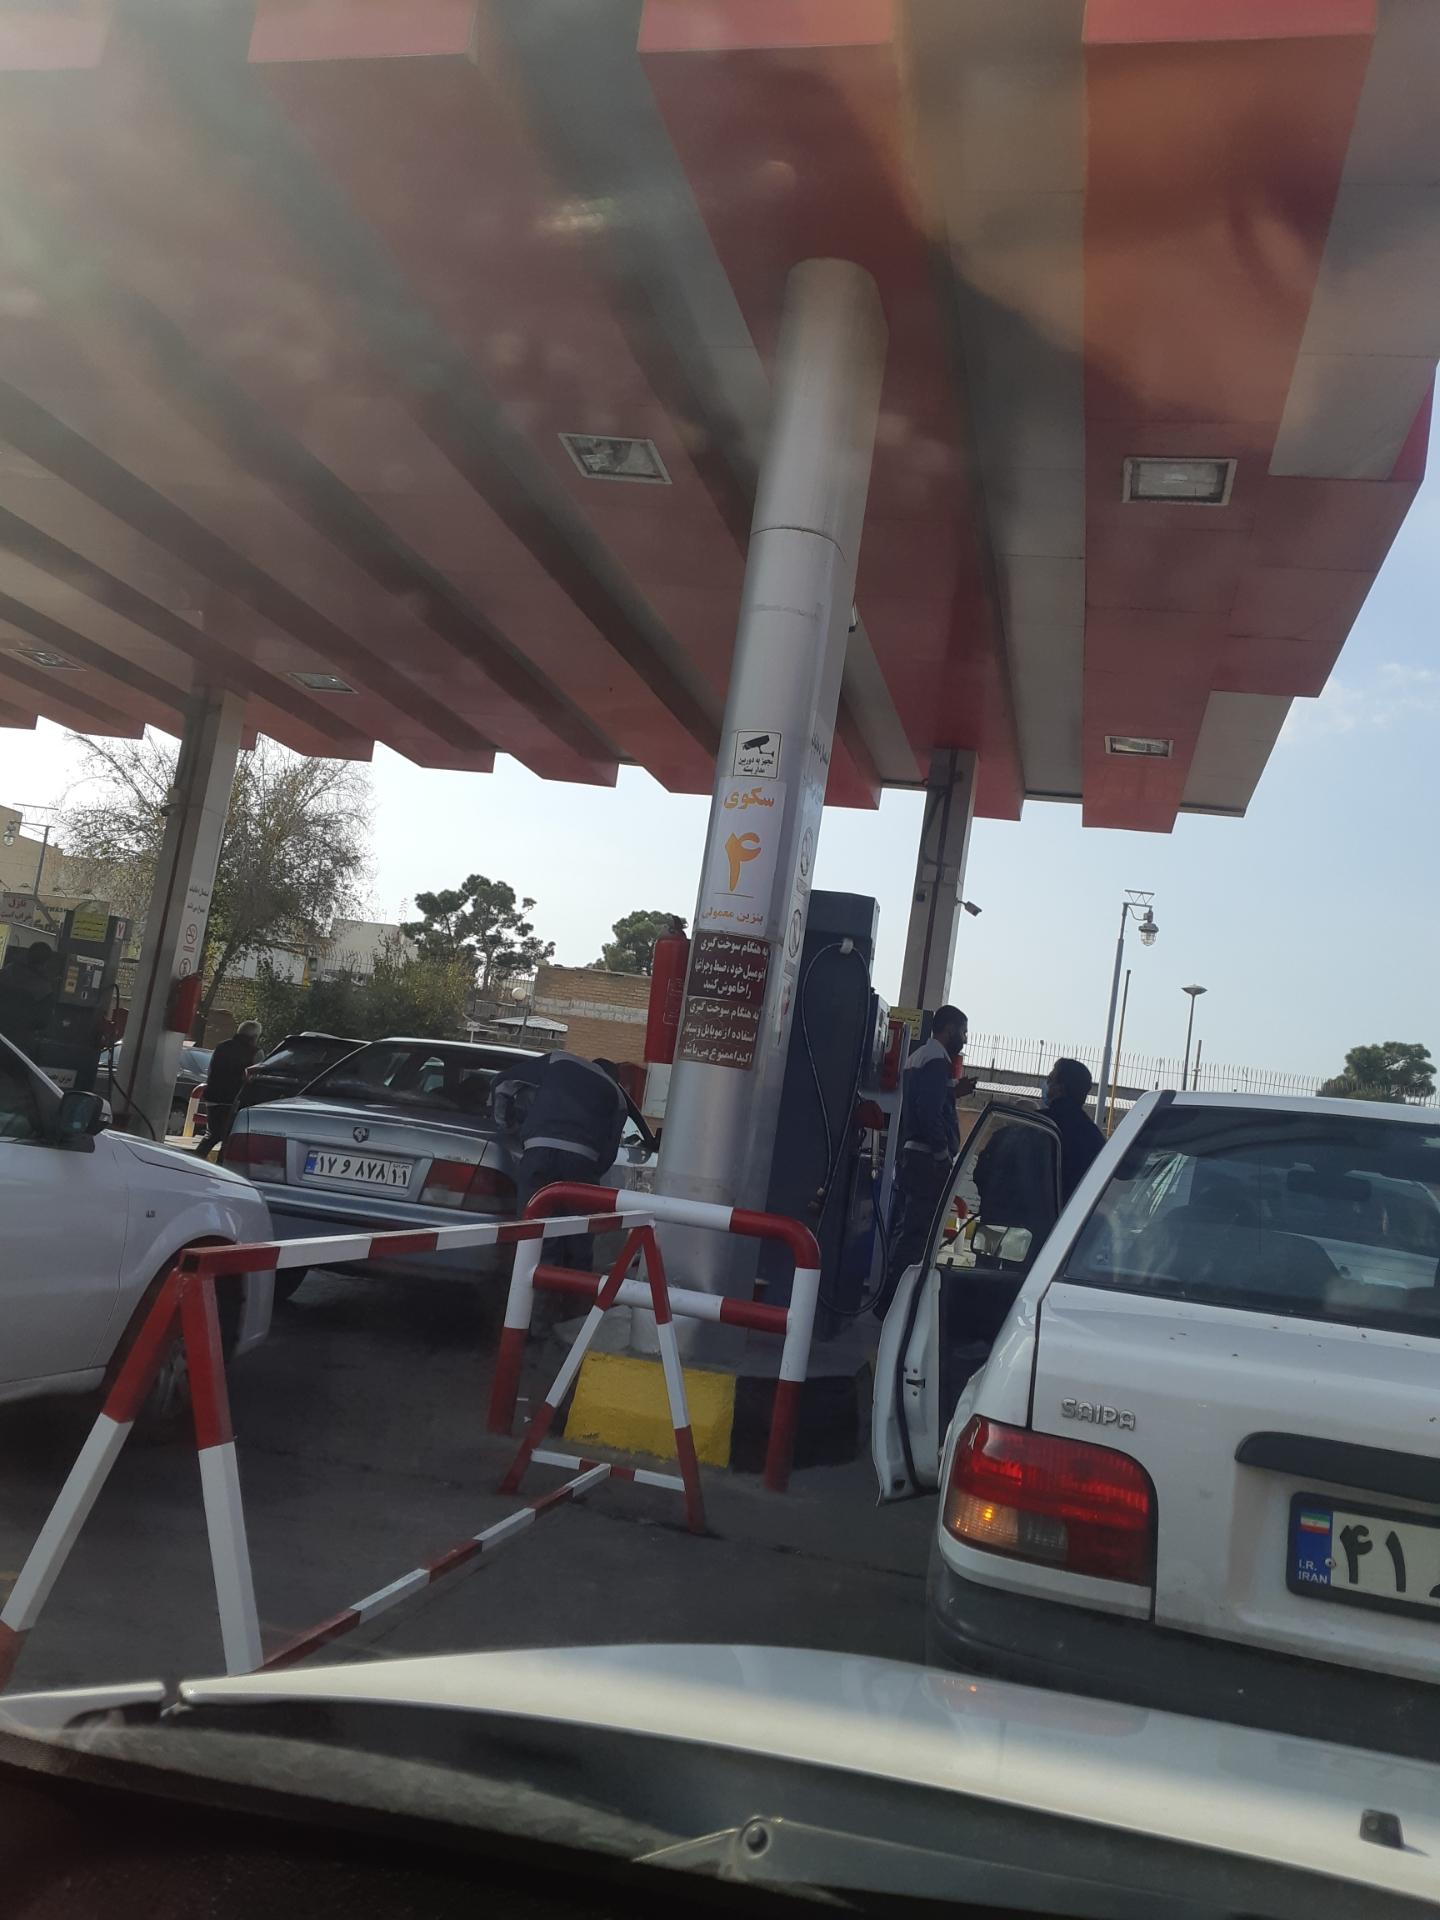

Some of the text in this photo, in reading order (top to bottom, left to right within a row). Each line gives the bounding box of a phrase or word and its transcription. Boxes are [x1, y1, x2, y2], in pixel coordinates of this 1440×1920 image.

[724, 786, 775, 810] سکوی
[725, 832, 762, 892] ۴
[702, 906, 763, 925] بنزین معمولی
[700, 936, 769, 959] به هنگام سوخت گیری
[742, 964, 766, 982] اتومبیل
[703, 979, 719, 993] کنید
[718, 980, 745, 996] خاموش
[689, 1001, 760, 1024] به هنگام سوخت گیری
[701, 1024, 722, 1040] موبایل
[731, 1030, 756, 1042] استفاده
[318, 1156, 338, 1175] ۱۷
[355, 1160, 386, 1181] ۸۷۸
[1061, 1397, 1136, 1431] SAIPA
[1298, 1571, 1328, 1585] IRAN
